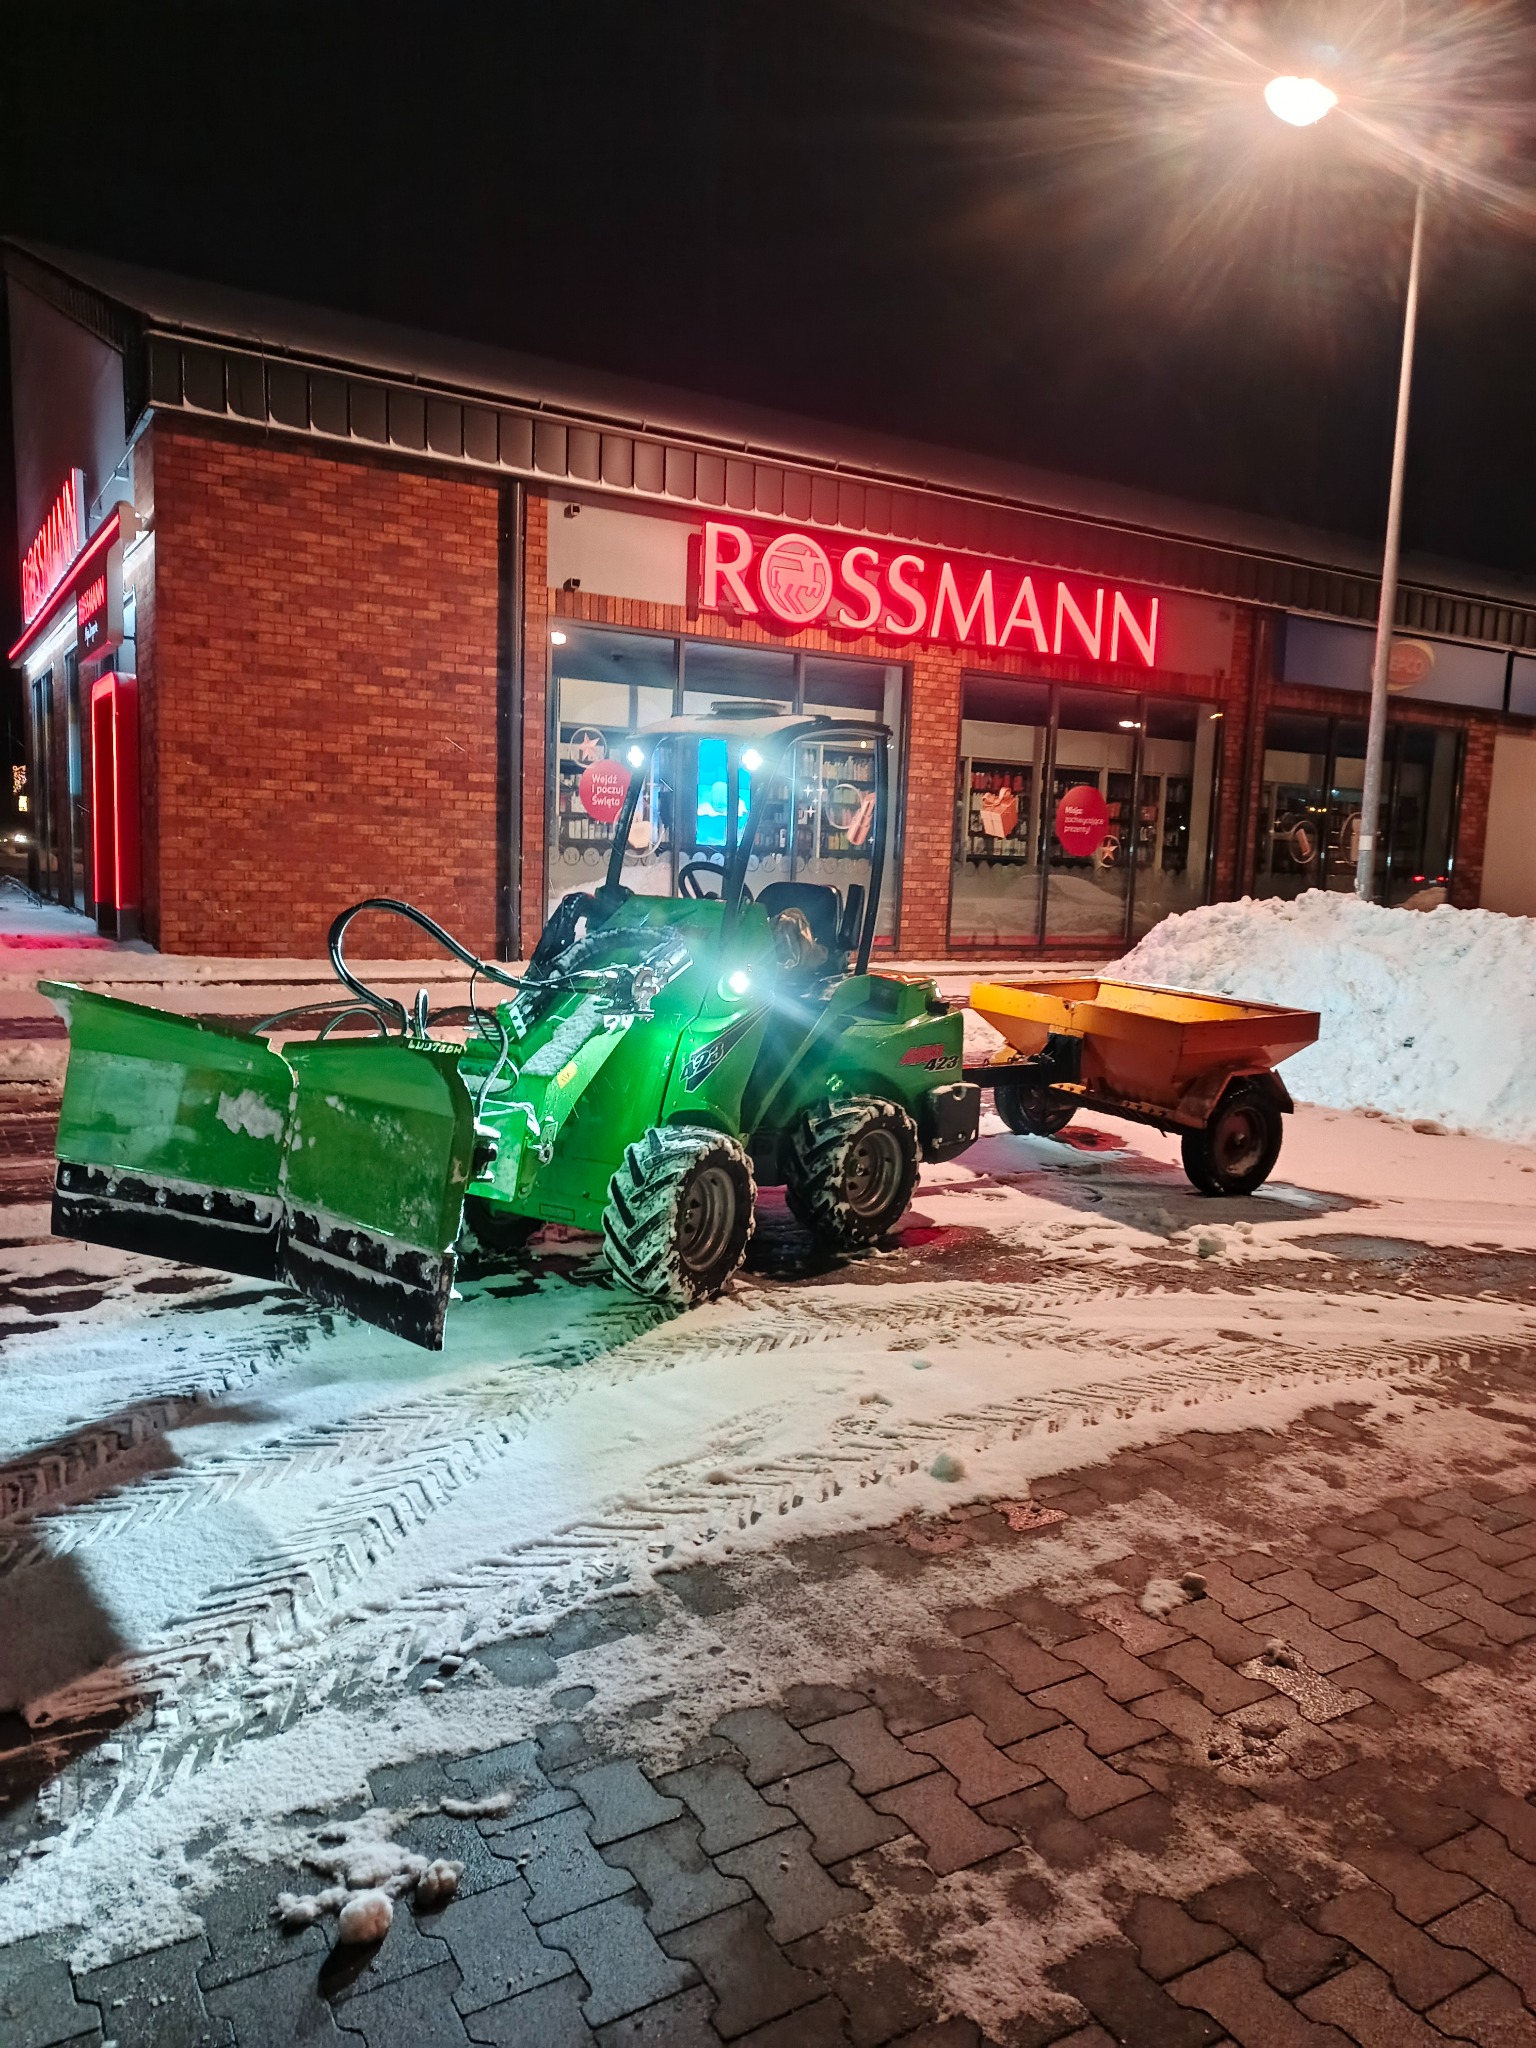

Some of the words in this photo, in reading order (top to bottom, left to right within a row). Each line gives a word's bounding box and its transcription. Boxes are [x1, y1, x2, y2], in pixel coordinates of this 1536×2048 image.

[22, 467, 80, 624] ROSSMANN
[702, 520, 1159, 668] ROSSMANN
[591, 774, 617, 785] Wejdź
[596, 785, 624, 796] poczuj
[591, 794, 620, 808] Święta
[679, 1042, 725, 1082] 423
[923, 1055, 960, 1073] 423
